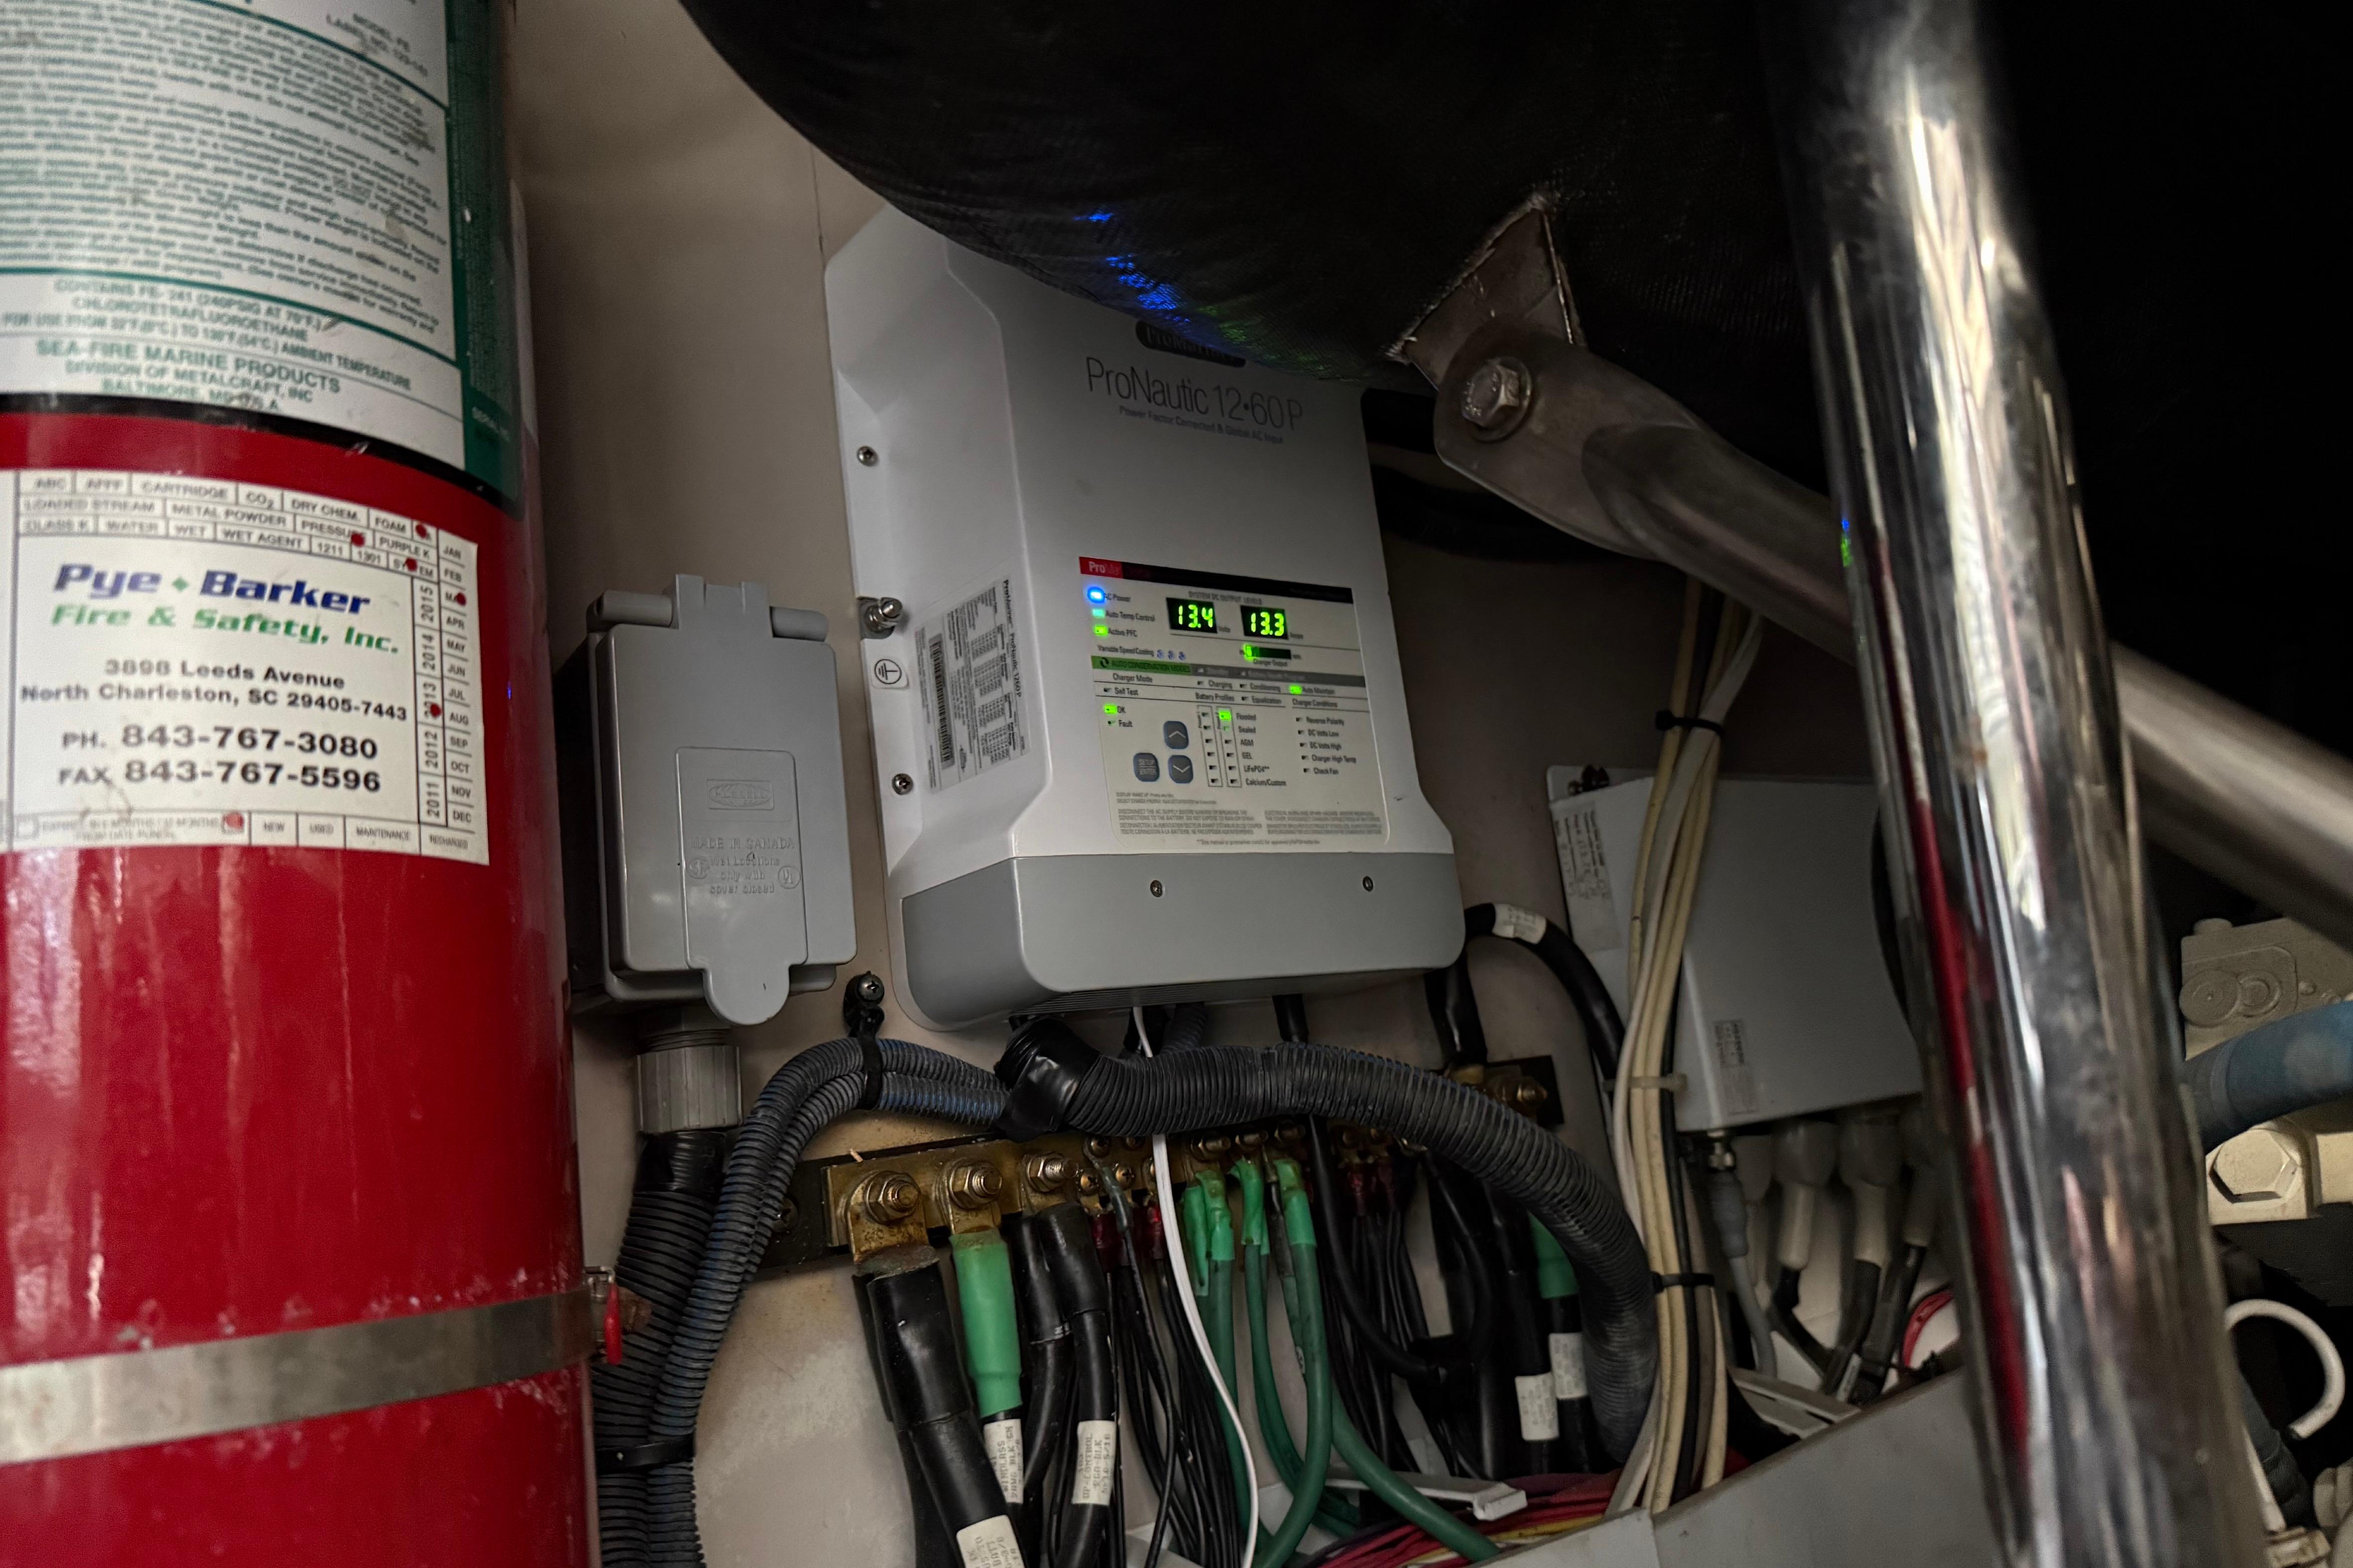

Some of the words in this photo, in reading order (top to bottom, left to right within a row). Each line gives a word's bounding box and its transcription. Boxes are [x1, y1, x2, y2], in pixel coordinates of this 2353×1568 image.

[145, 345, 228, 371] MARINE
[235, 357, 340, 393] PRODUCTS
[146, 365, 168, 379] OF
[1087, 356, 1209, 415] ProNautic
[141, 481, 228, 498] CARTRIDGE
[92, 498, 156, 512] STREAM
[292, 498, 318, 513] DRY
[172, 504, 218, 518] METAL
[223, 506, 287, 526] POWDER
[106, 519, 161, 533] WATER
[175, 524, 206, 538] WET
[301, 520, 367, 541] PRESSU
[375, 517, 407, 533] FOAM
[222, 527, 251, 542] WET
[258, 531, 303, 548] AGENT
[317, 542, 344, 557] 1211
[380, 536, 419, 556] PURPLE
[423, 549, 430, 560] K
[443, 546, 461, 560] JAN
[394, 559, 434, 577] SYEM
[444, 567, 462, 583] FEB
[53, 563, 163, 599] Pye
[200, 569, 371, 615] Barker
[419, 586, 434, 623] 2015
[446, 616, 465, 629] APR
[1120, 611, 1135, 620] Temp
[1135, 613, 1155, 622] Control
[1178, 604, 1213, 628] 13.4
[1251, 611, 1284, 636] 13.3
[52, 603, 131, 626] Fire
[147, 606, 176, 627] &
[193, 608, 329, 645] Safety,
[344, 626, 399, 654] Inc.
[421, 633, 436, 672] 2014
[446, 639, 465, 654] MAY
[180, 660, 254, 681] Leeds
[264, 666, 345, 689] Avenue
[448, 663, 466, 677] JUN
[1113, 673, 1135, 683] Charger
[1136, 674, 1153, 683] Mode
[1209, 680, 1233, 689] Charging
[449, 688, 466, 700] JUL
[1114, 686, 1126, 695] Self
[1195, 692, 1214, 701] Battery
[1215, 693, 1235, 702] Profiles
[21, 683, 90, 701] North
[100, 682, 239, 707] Charleston,
[248, 688, 278, 706] SC
[287, 691, 408, 721] 29405-7443
[1292, 698, 1312, 707] Charger
[449, 712, 469, 725] AUG
[62, 729, 106, 750] PH.
[122, 724, 378, 760] 843-767-3080
[450, 735, 468, 748] SEP
[1240, 738, 1254, 747] AGM
[425, 730, 438, 769] 2012
[451, 761, 470, 774] OCT
[59, 767, 110, 785] FAX
[125, 759, 381, 793] 843-767-5596
[451, 785, 471, 798] NOV
[426, 782, 440, 818] 2011
[453, 810, 472, 823] DEC
[691, 836, 724, 849] MADE
[730, 837, 741, 850] IN
[745, 837, 795, 850] CANADA
